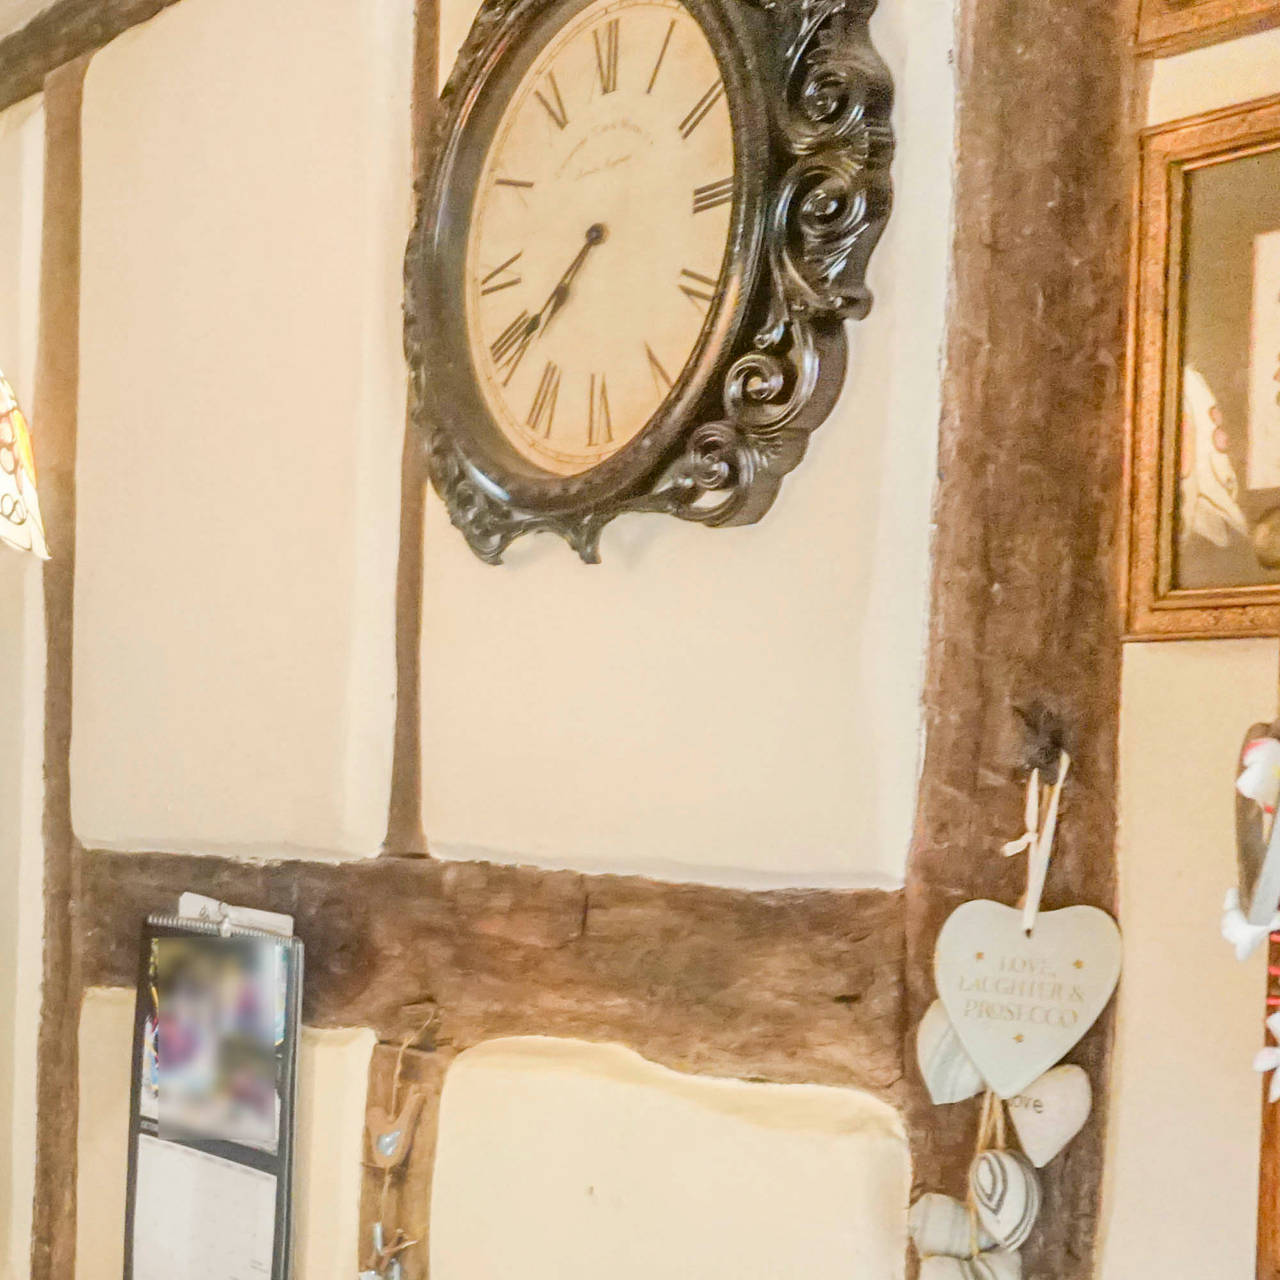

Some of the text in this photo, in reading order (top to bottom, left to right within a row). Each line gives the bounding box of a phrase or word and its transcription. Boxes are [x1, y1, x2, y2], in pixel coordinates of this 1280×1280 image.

[958, 975, 1086, 1003] LAUGHTER &
[962, 998, 1080, 1029] PROSECCO
[1008, 1094, 1044, 1115] ove
